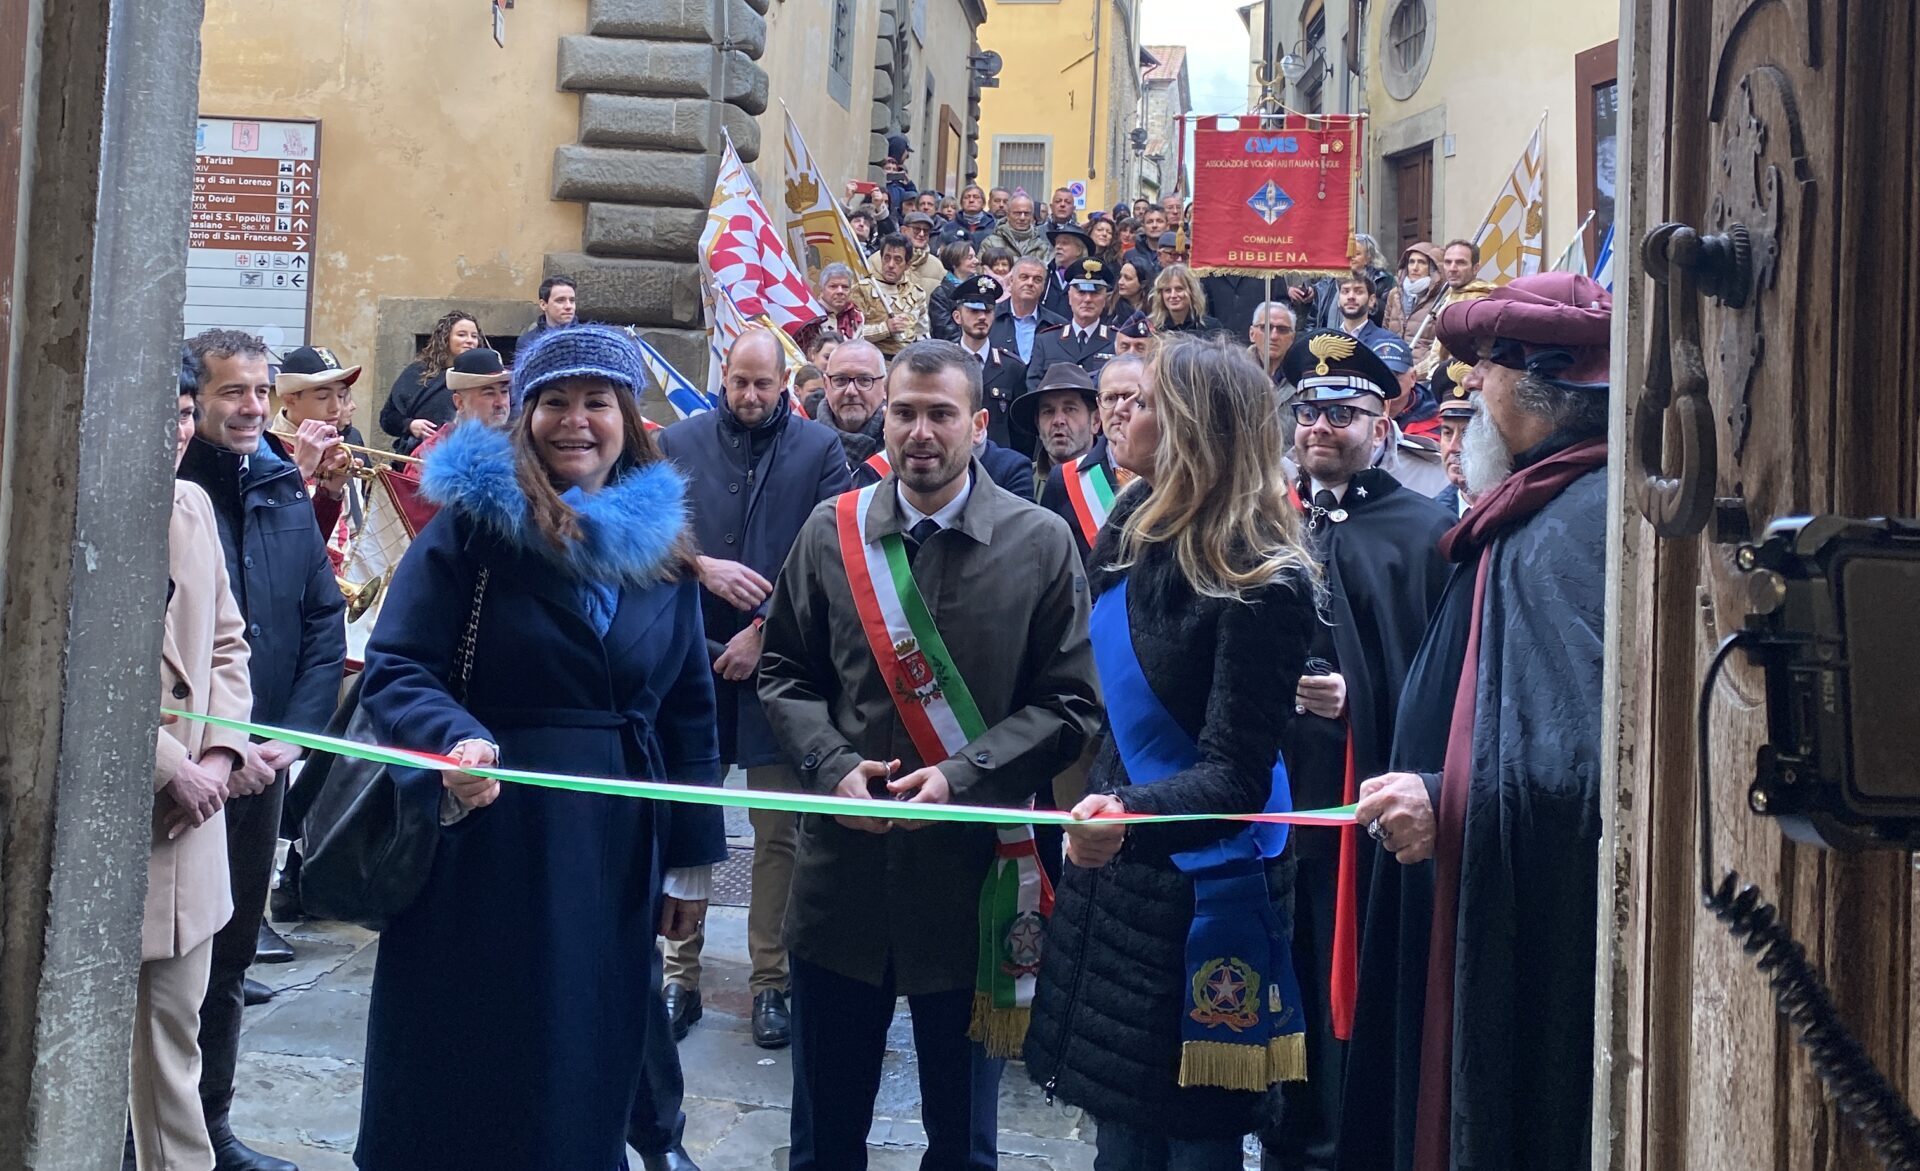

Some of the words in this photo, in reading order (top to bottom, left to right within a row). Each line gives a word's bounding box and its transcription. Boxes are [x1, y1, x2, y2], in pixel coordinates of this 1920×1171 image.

[1245, 137, 1299, 153] AVIS
[205, 156, 234, 165] Tarlati
[1205, 160, 1249, 168] ASSOCIAZIONE
[1250, 160, 1288, 168] VOLONTARI
[219, 176, 236, 185] San
[239, 177, 272, 186] Lorenzo
[208, 194, 236, 203] Dovizi
[236, 214, 271, 223] Ippolito
[190, 221, 223, 229] assiano
[189, 231, 210, 240] torio
[212, 232, 221, 240] di
[223, 232, 240, 241] San
[243, 233, 288, 242] Francesco
[1243, 235, 1294, 244] COMUNALE
[1228, 251, 1308, 263] BIBBIENA
